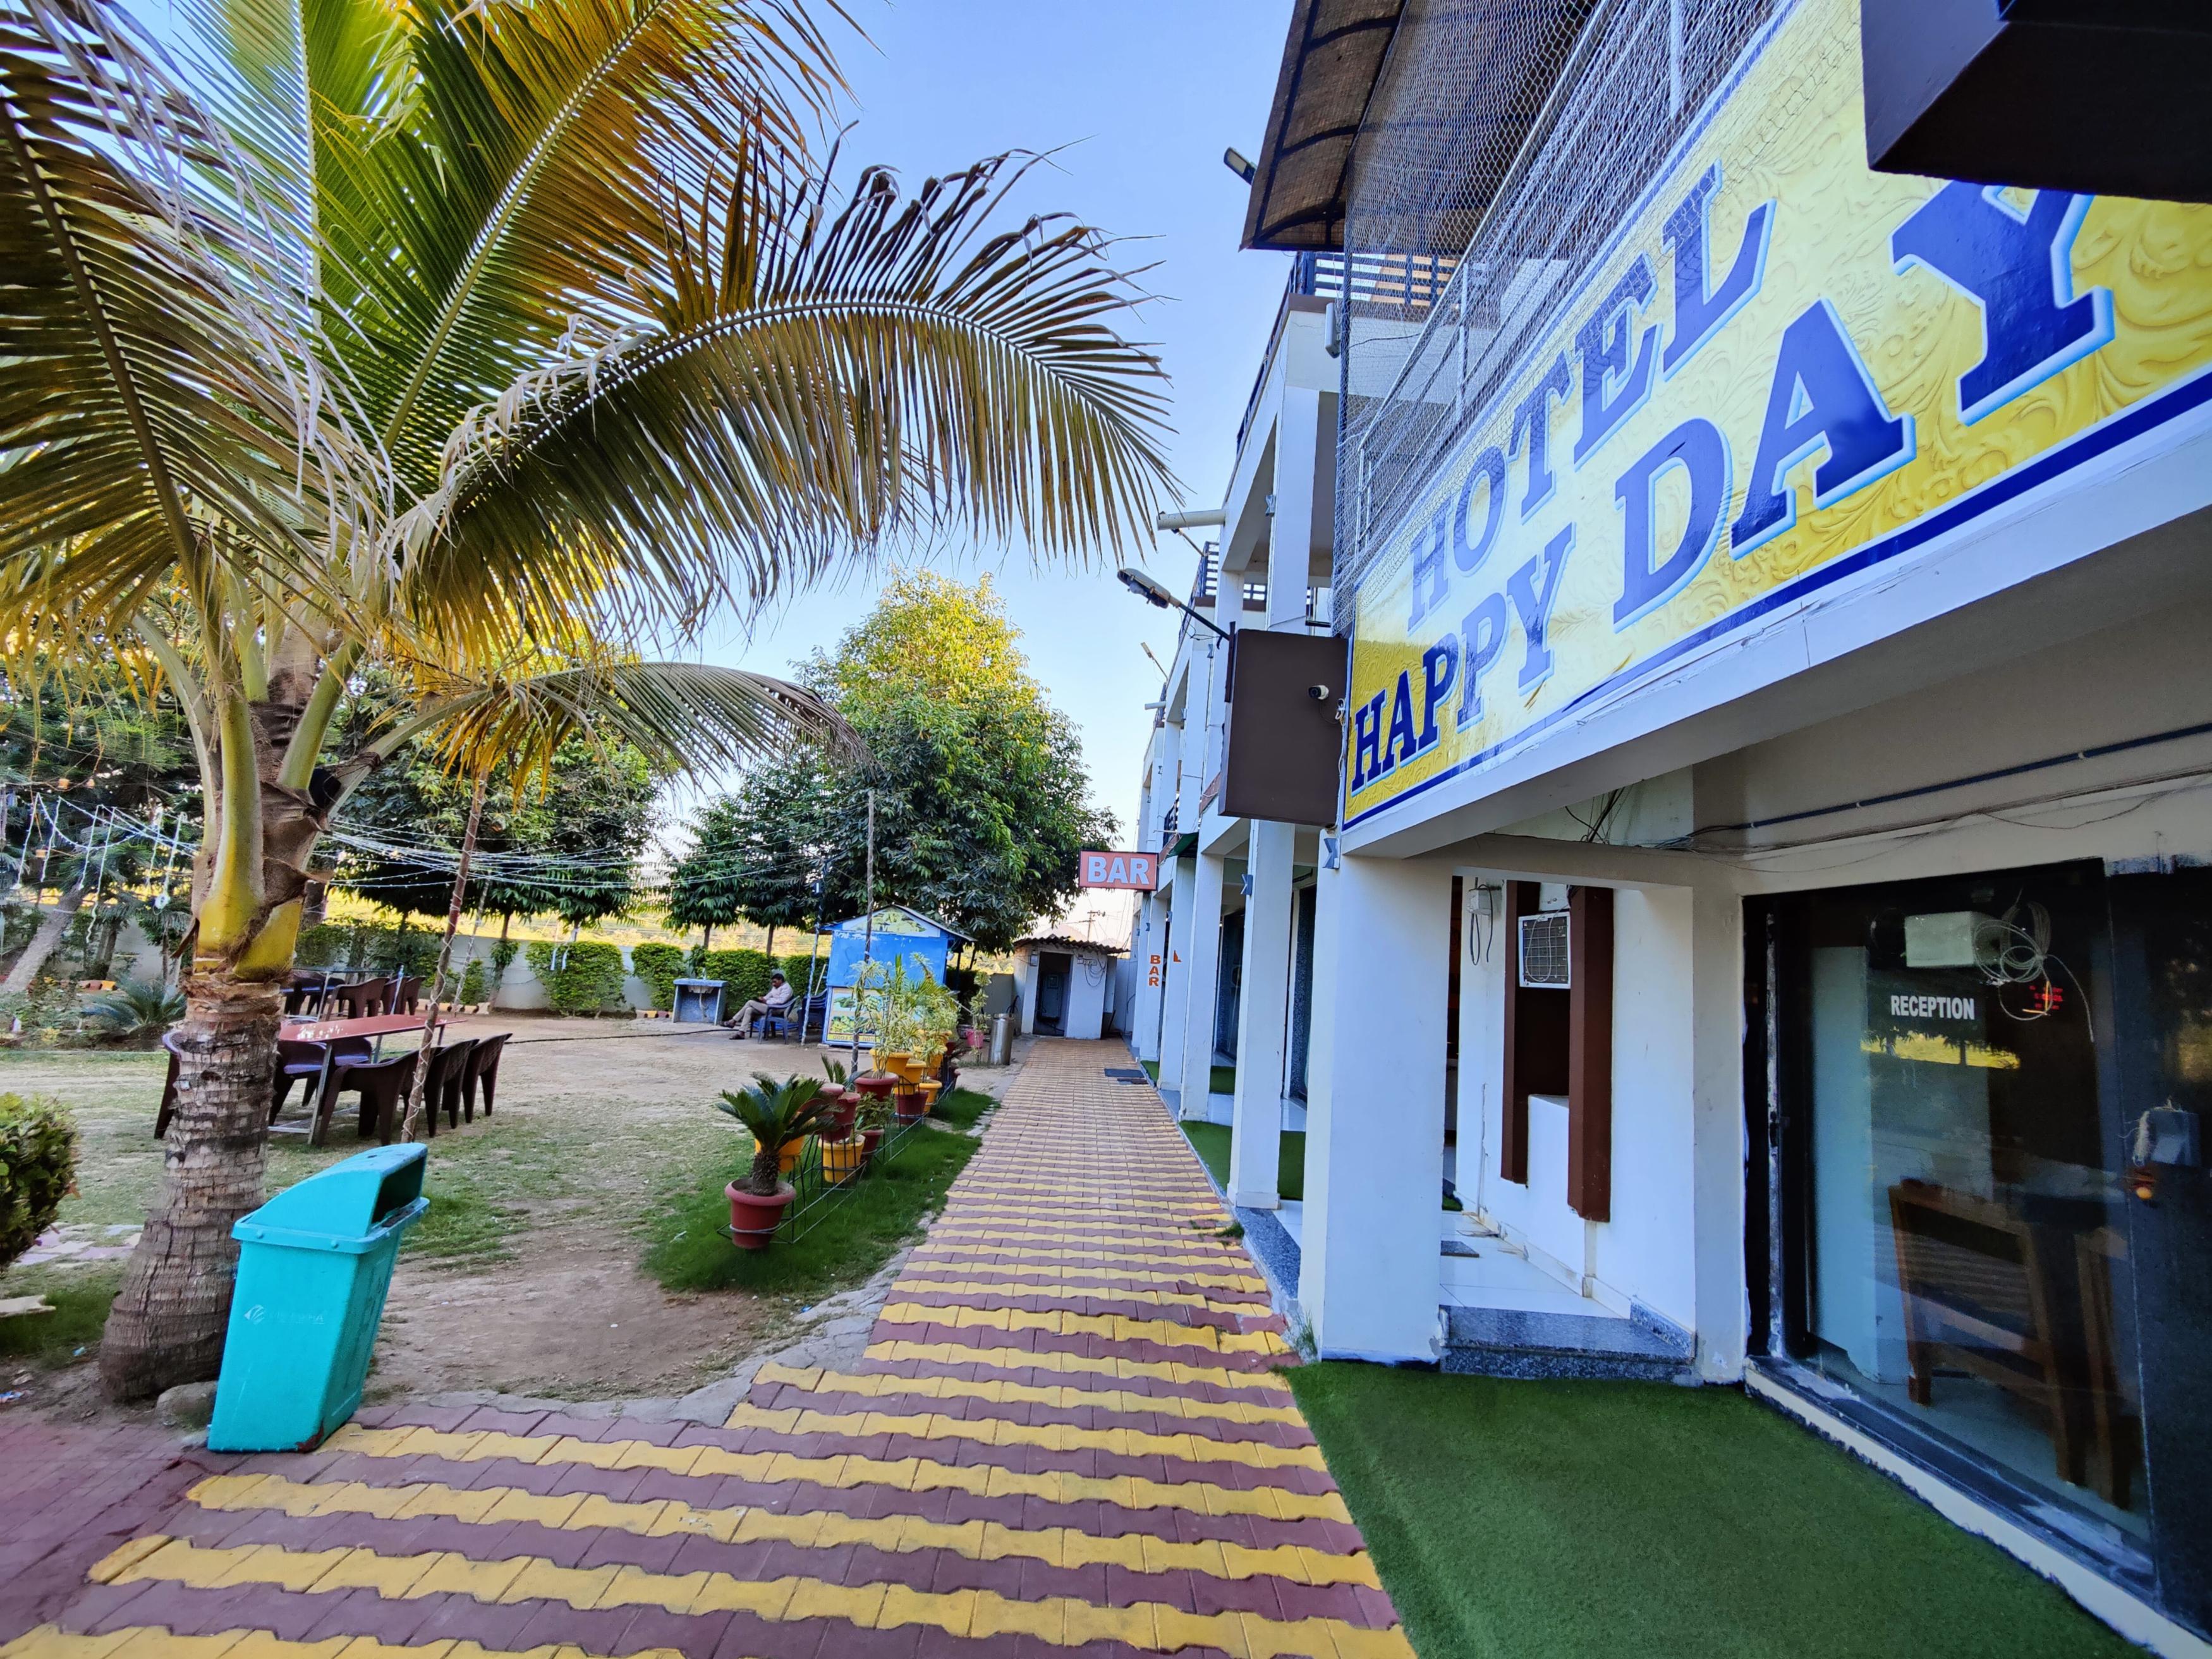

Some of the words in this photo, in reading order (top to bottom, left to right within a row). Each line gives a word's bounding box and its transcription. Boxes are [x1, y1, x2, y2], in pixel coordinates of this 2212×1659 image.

[1407, 159, 1777, 637] HOTEL
[1351, 521, 1576, 798] HAPPY
[1613, 179, 2115, 632] DAY
[1088, 856, 1150, 884] BAR
[1148, 954, 1161, 987] BAR
[1891, 995, 1976, 1020] RECEPTION
